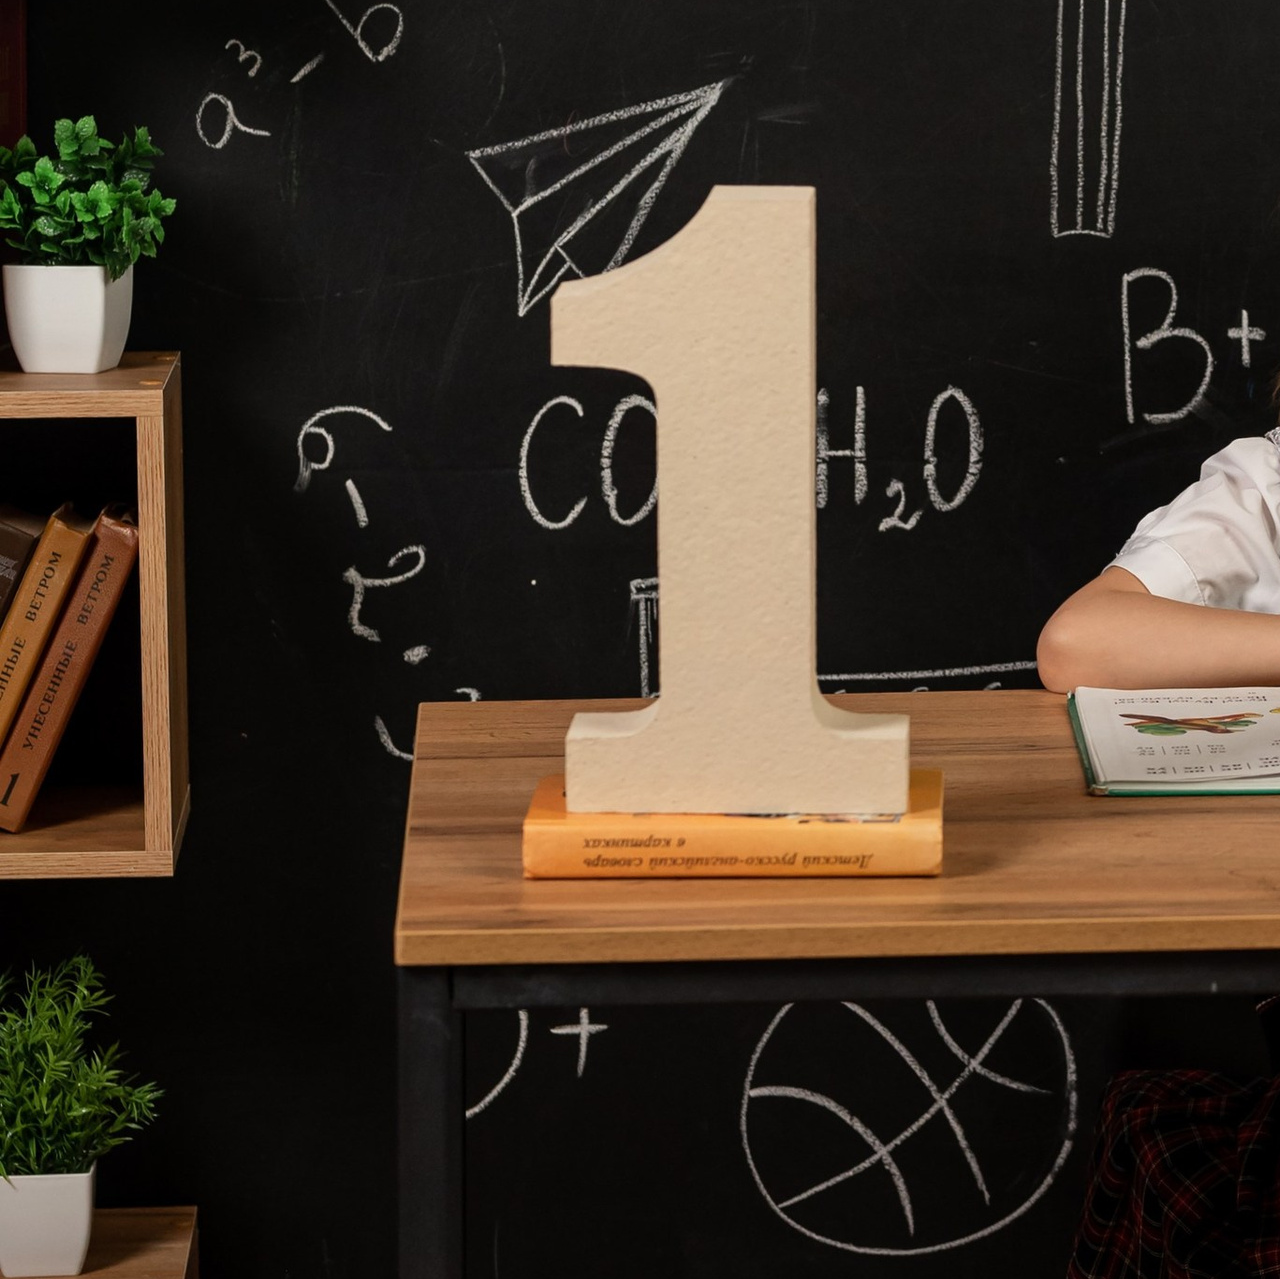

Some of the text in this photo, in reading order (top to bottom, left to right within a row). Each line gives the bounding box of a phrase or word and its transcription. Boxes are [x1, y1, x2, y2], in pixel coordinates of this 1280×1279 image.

[22, 553, 114, 751] УНЕСЕННЫЕ ВЕТРОМ
[25, 550, 62, 622] ВЕТРОМ
